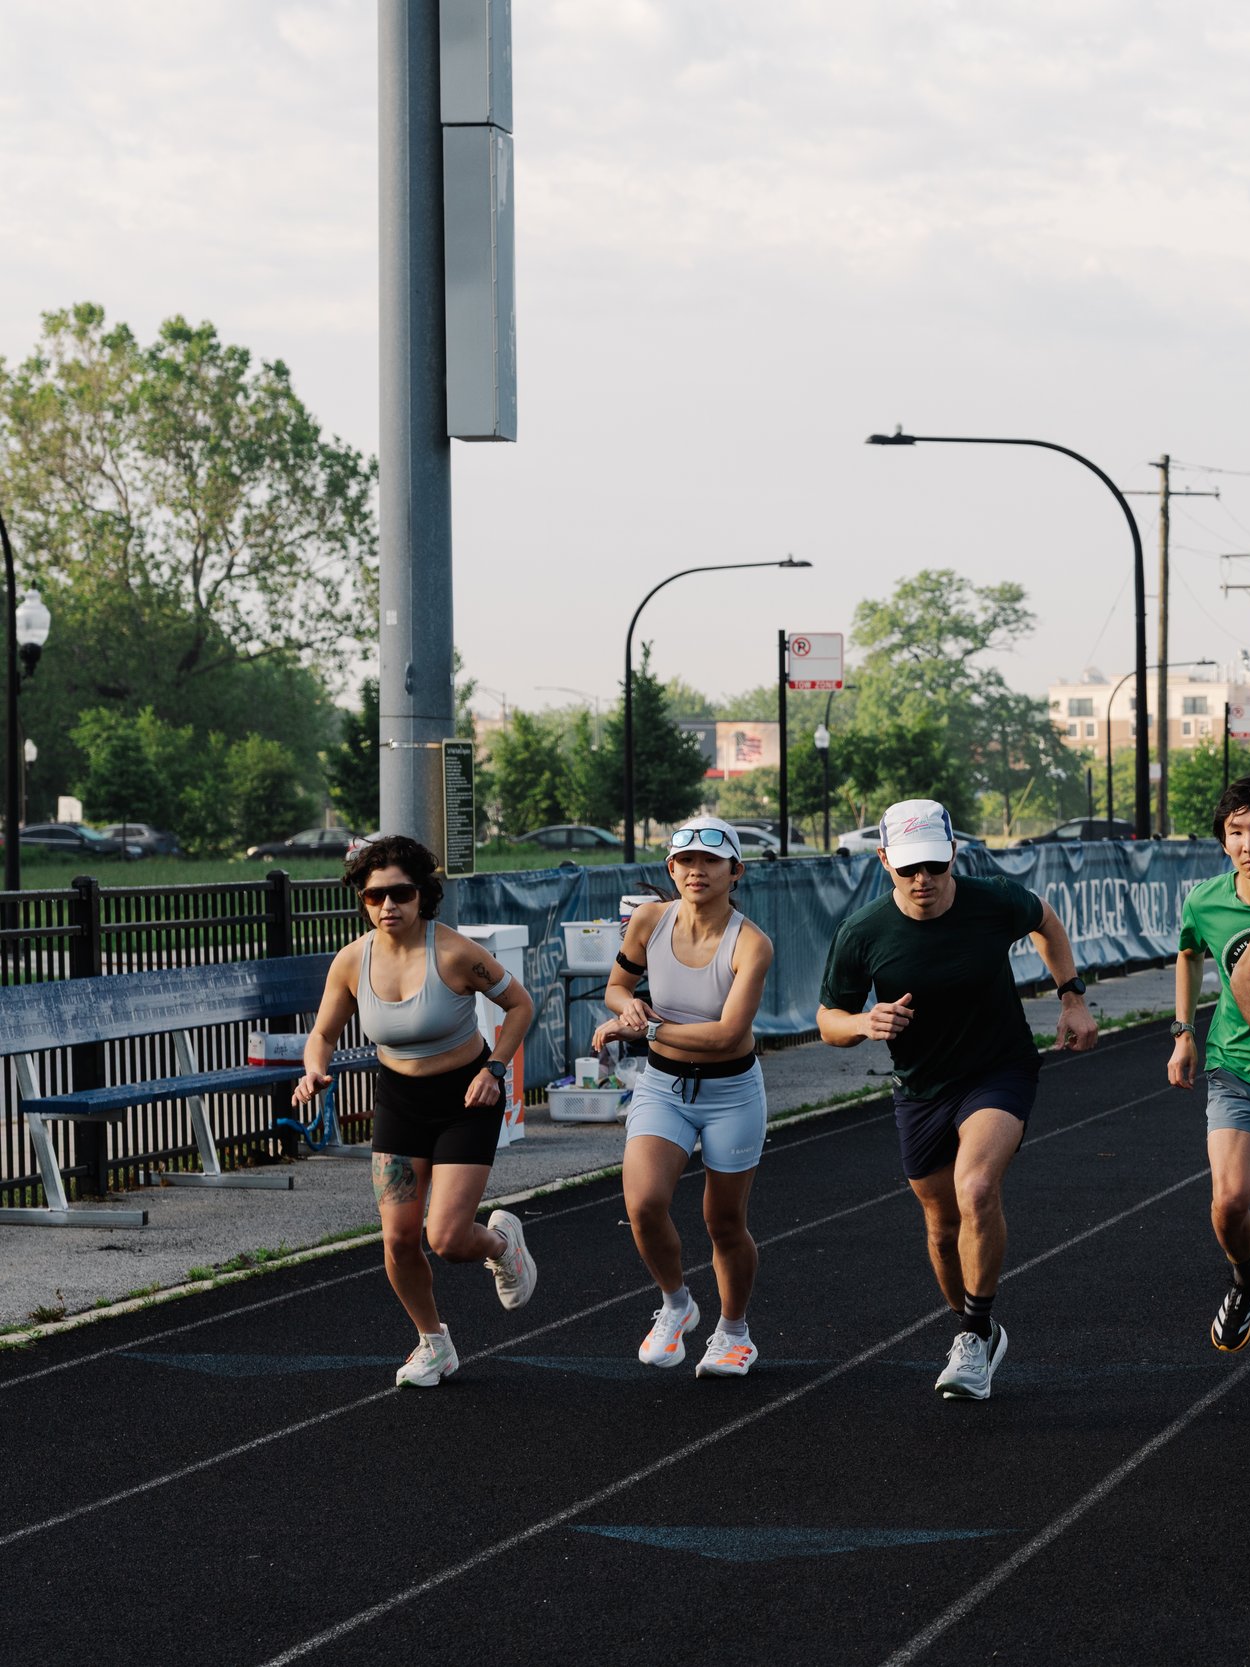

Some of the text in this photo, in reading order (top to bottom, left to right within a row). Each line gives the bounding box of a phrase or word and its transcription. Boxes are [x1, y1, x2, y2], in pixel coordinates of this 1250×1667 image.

[795, 680, 836, 690] TOW ZONE
[1233, 941, 1249, 957] BANK
